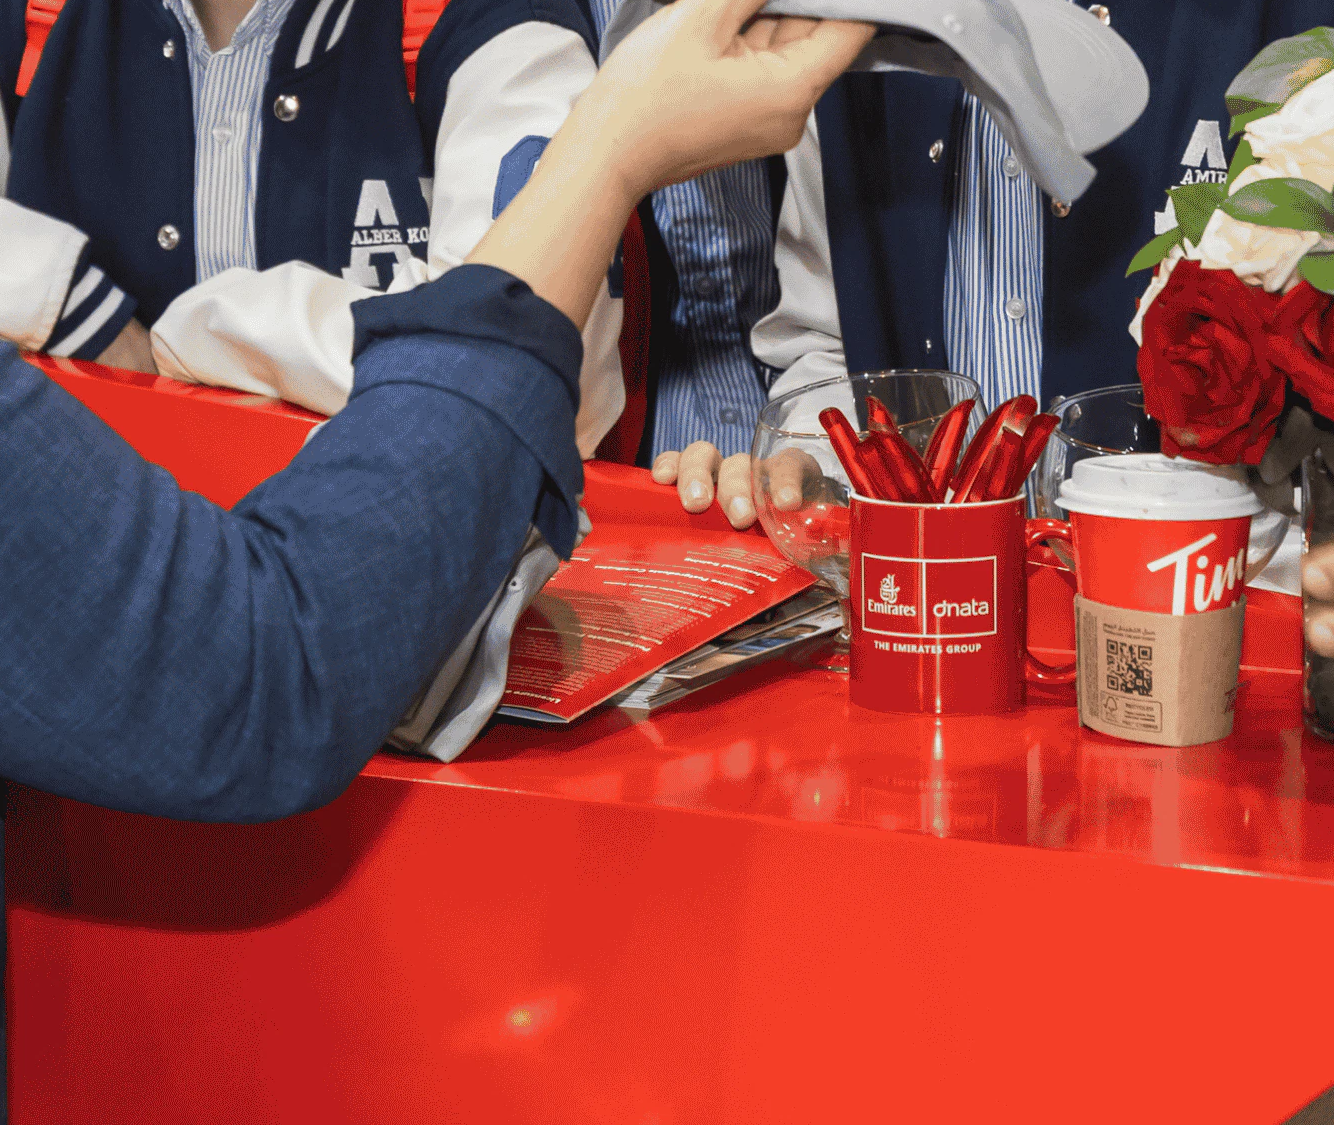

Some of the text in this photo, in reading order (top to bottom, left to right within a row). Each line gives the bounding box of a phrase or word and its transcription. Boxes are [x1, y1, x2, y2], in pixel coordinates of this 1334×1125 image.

[1180, 168, 1228, 185] AMIR
[351, 230, 403, 245] ALBER
[867, 598, 917, 616] Emirates
[933, 598, 989, 617] dnata
[873, 640, 982, 654] THE EMIRATES GROUP
